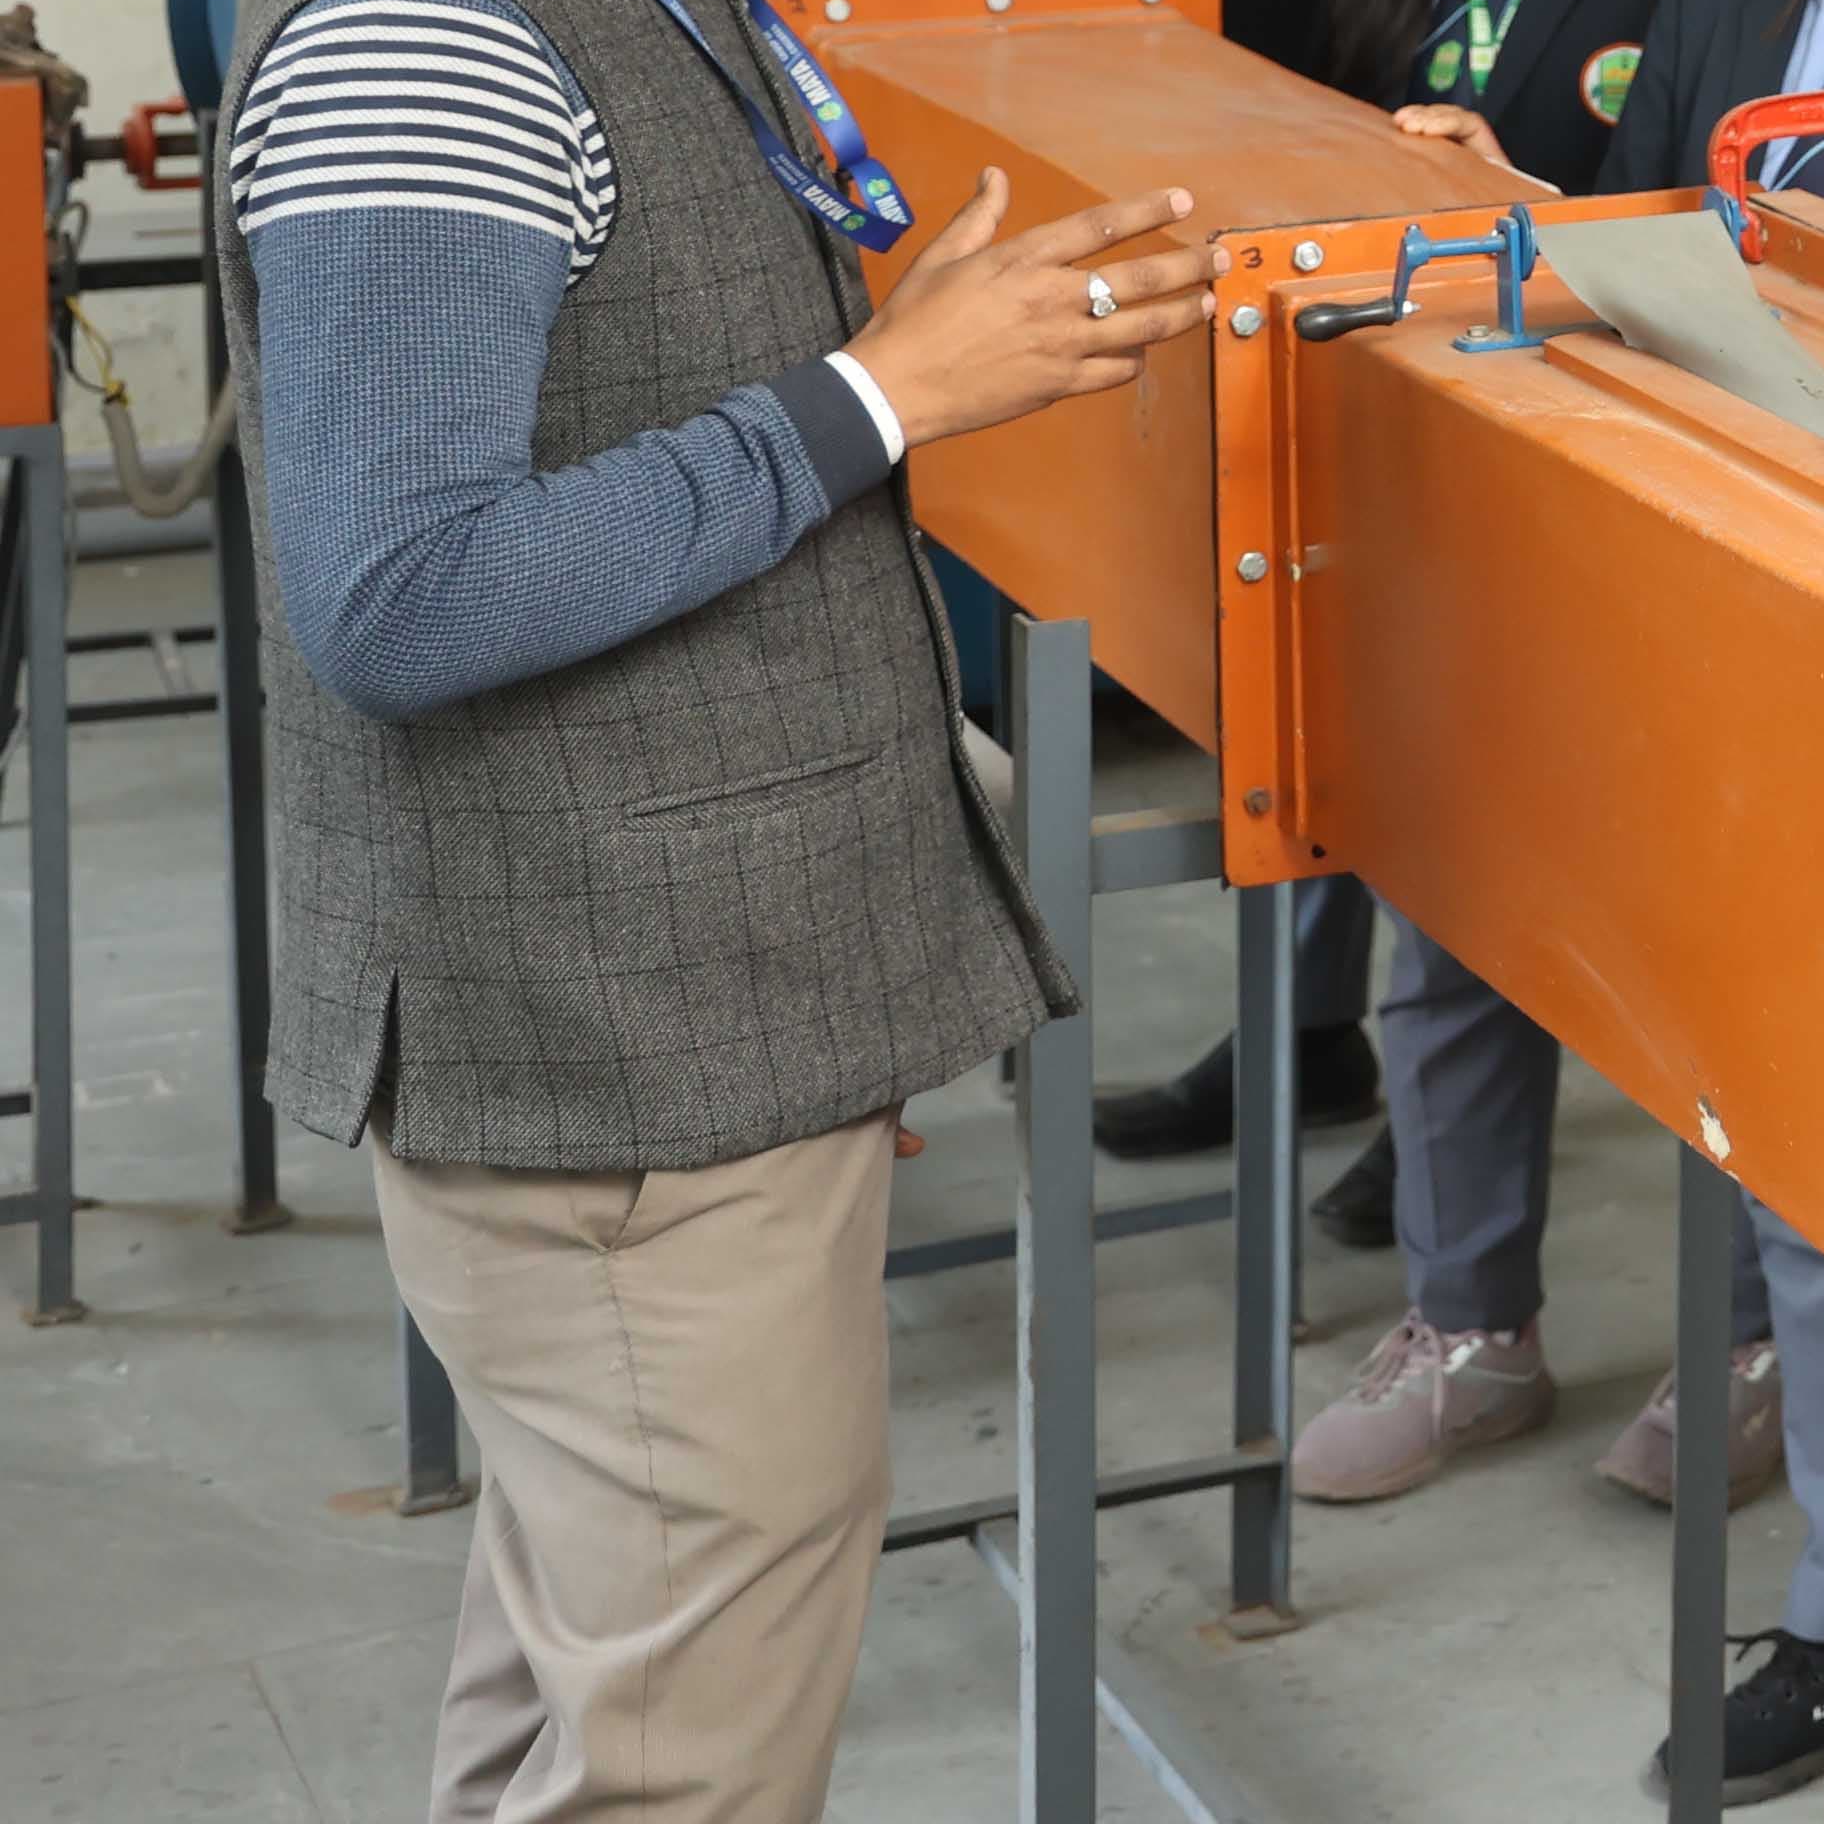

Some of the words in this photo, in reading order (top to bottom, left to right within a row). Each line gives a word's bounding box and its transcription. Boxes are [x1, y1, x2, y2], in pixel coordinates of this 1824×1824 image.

[790, 58, 833, 108] MAYA
[803, 184, 851, 222] MAYA
[874, 194, 908, 224] MAY
[1239, 246, 1264, 269] 3
